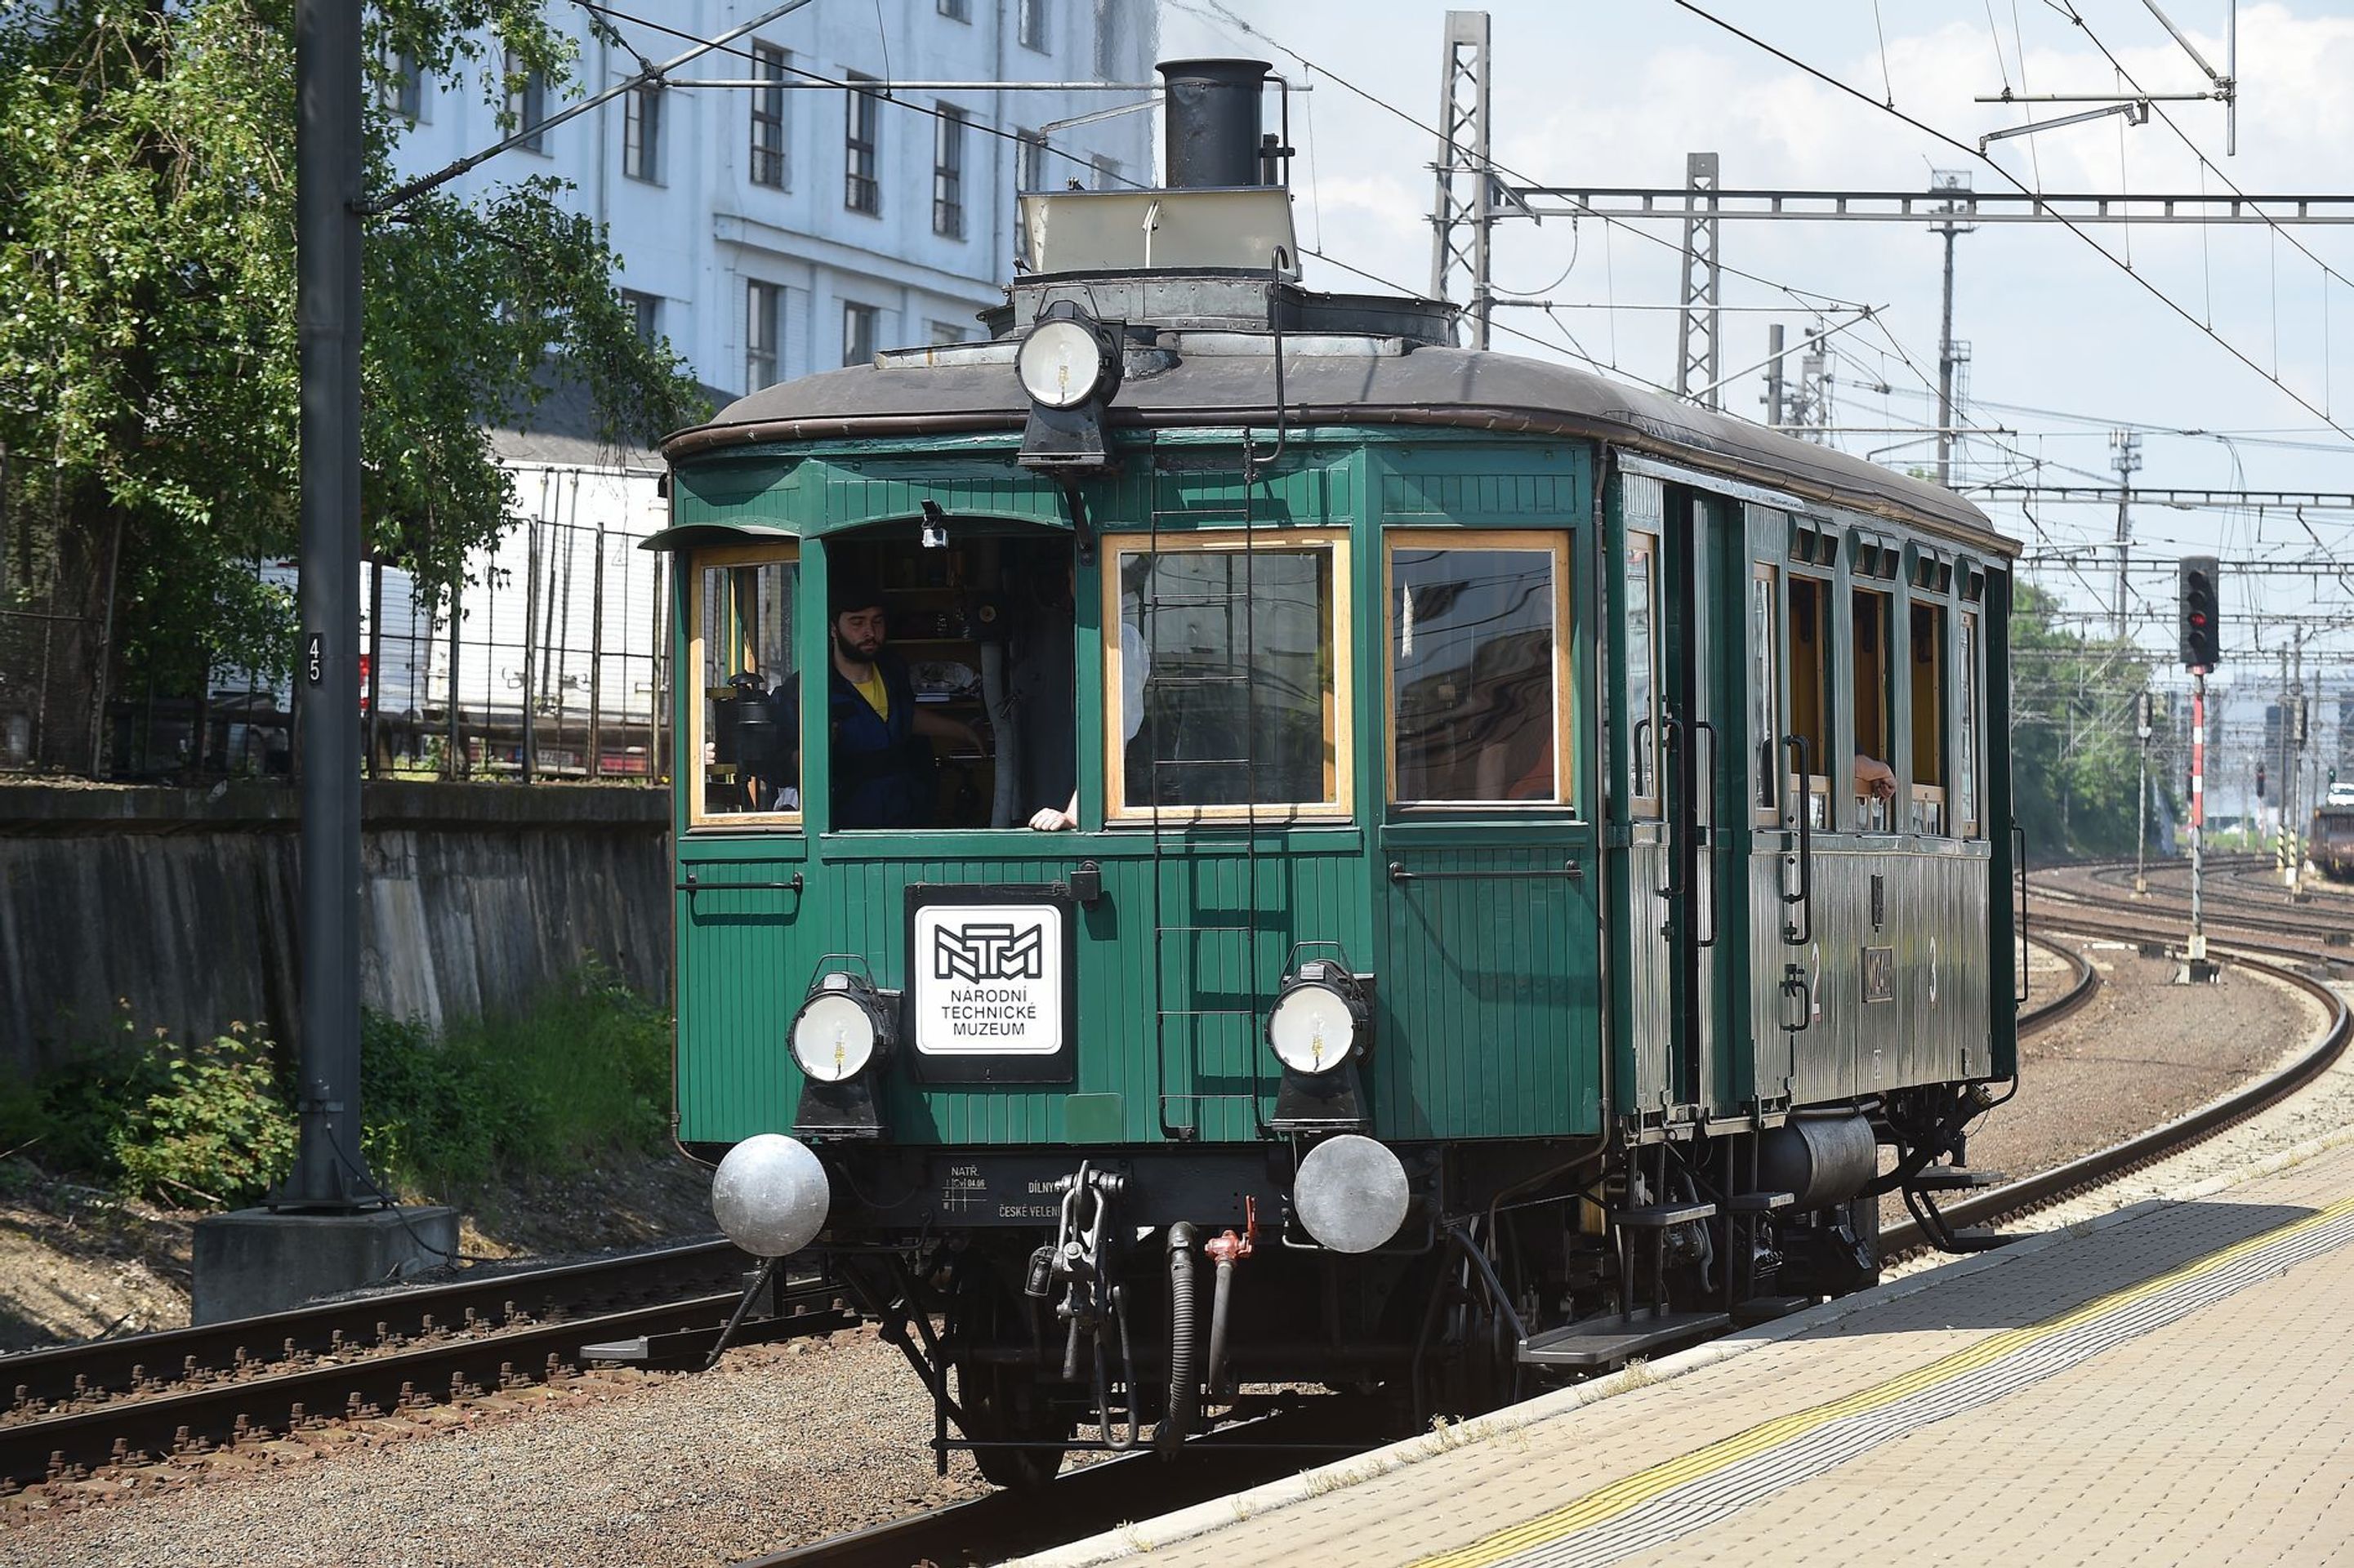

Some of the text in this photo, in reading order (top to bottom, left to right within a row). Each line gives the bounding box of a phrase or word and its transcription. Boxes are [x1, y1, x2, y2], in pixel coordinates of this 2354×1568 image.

[310, 638, 320, 680] 45
[934, 924, 1041, 984] NTM
[1812, 942, 1821, 1014] 2
[1929, 936, 1937, 1003] 3
[951, 986, 1027, 1003] NÁRODNÍ
[941, 1002, 1037, 1019] TECHNICKÉ
[953, 1022, 1025, 1036] MUZEUM
[1028, 1179, 1054, 1193] DÍLNY
[999, 1204, 1060, 1217] ČESKÉ VELENI
